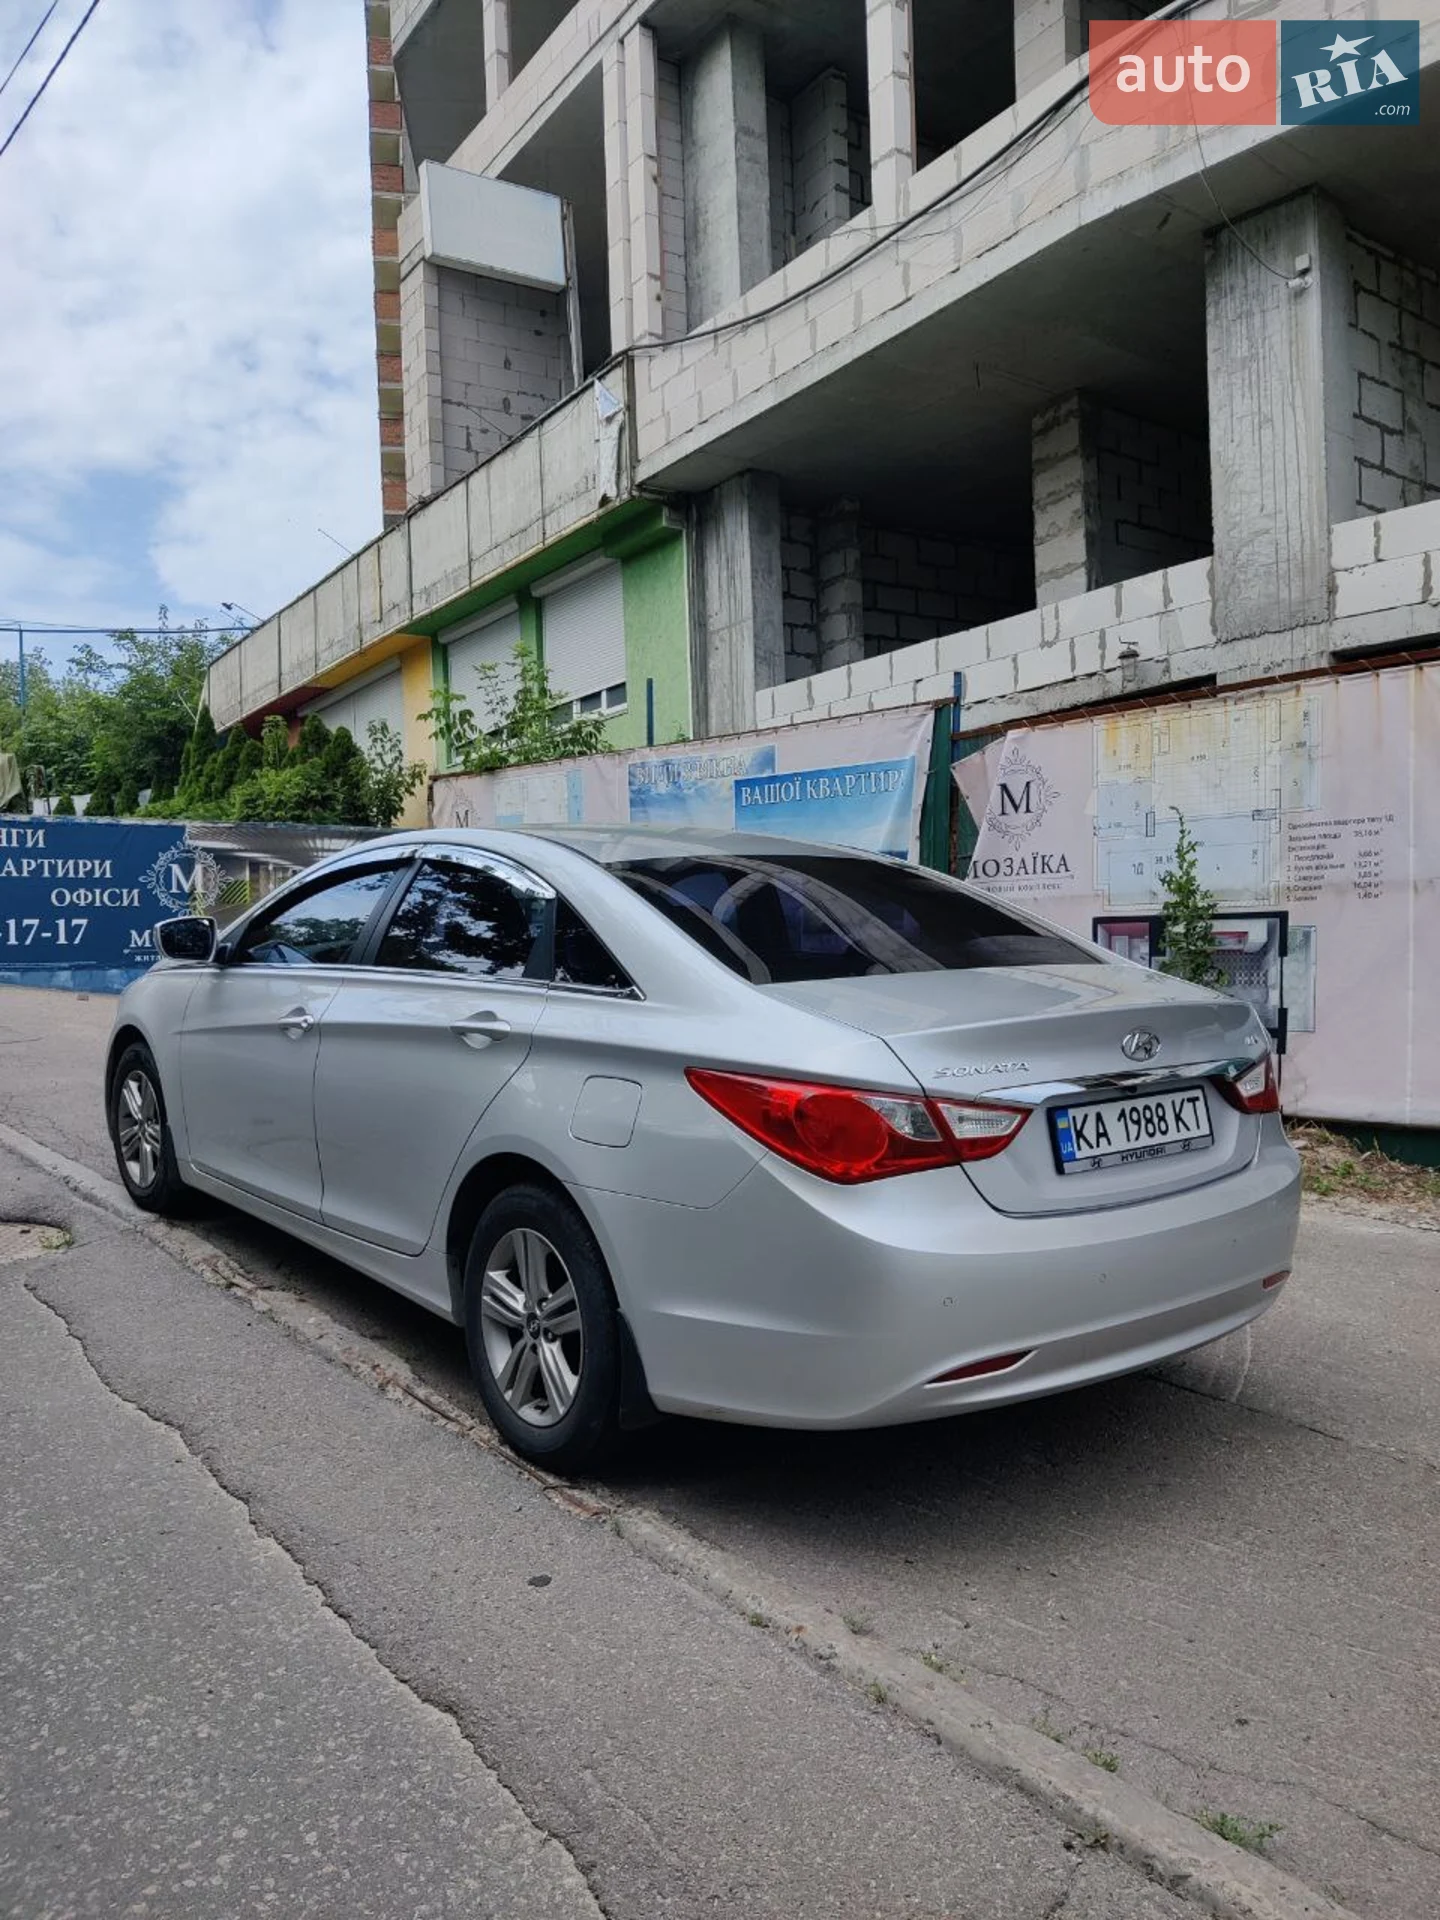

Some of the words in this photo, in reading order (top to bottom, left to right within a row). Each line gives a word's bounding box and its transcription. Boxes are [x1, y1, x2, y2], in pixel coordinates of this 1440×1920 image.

[741, 776, 801, 807] ВАШОЇ
[51, 887, 141, 907] ОФІСИ
[0, 918, 88, 945] 17-17
[932, 1062, 1030, 1080] SONATA
[1072, 1112, 1112, 1151] KA
[1117, 1102, 1169, 1142] 1988
[1171, 1096, 1200, 1133] KT
[1060, 1143, 1074, 1154] UA
[1121, 1146, 1166, 1162] HYUNDAI
